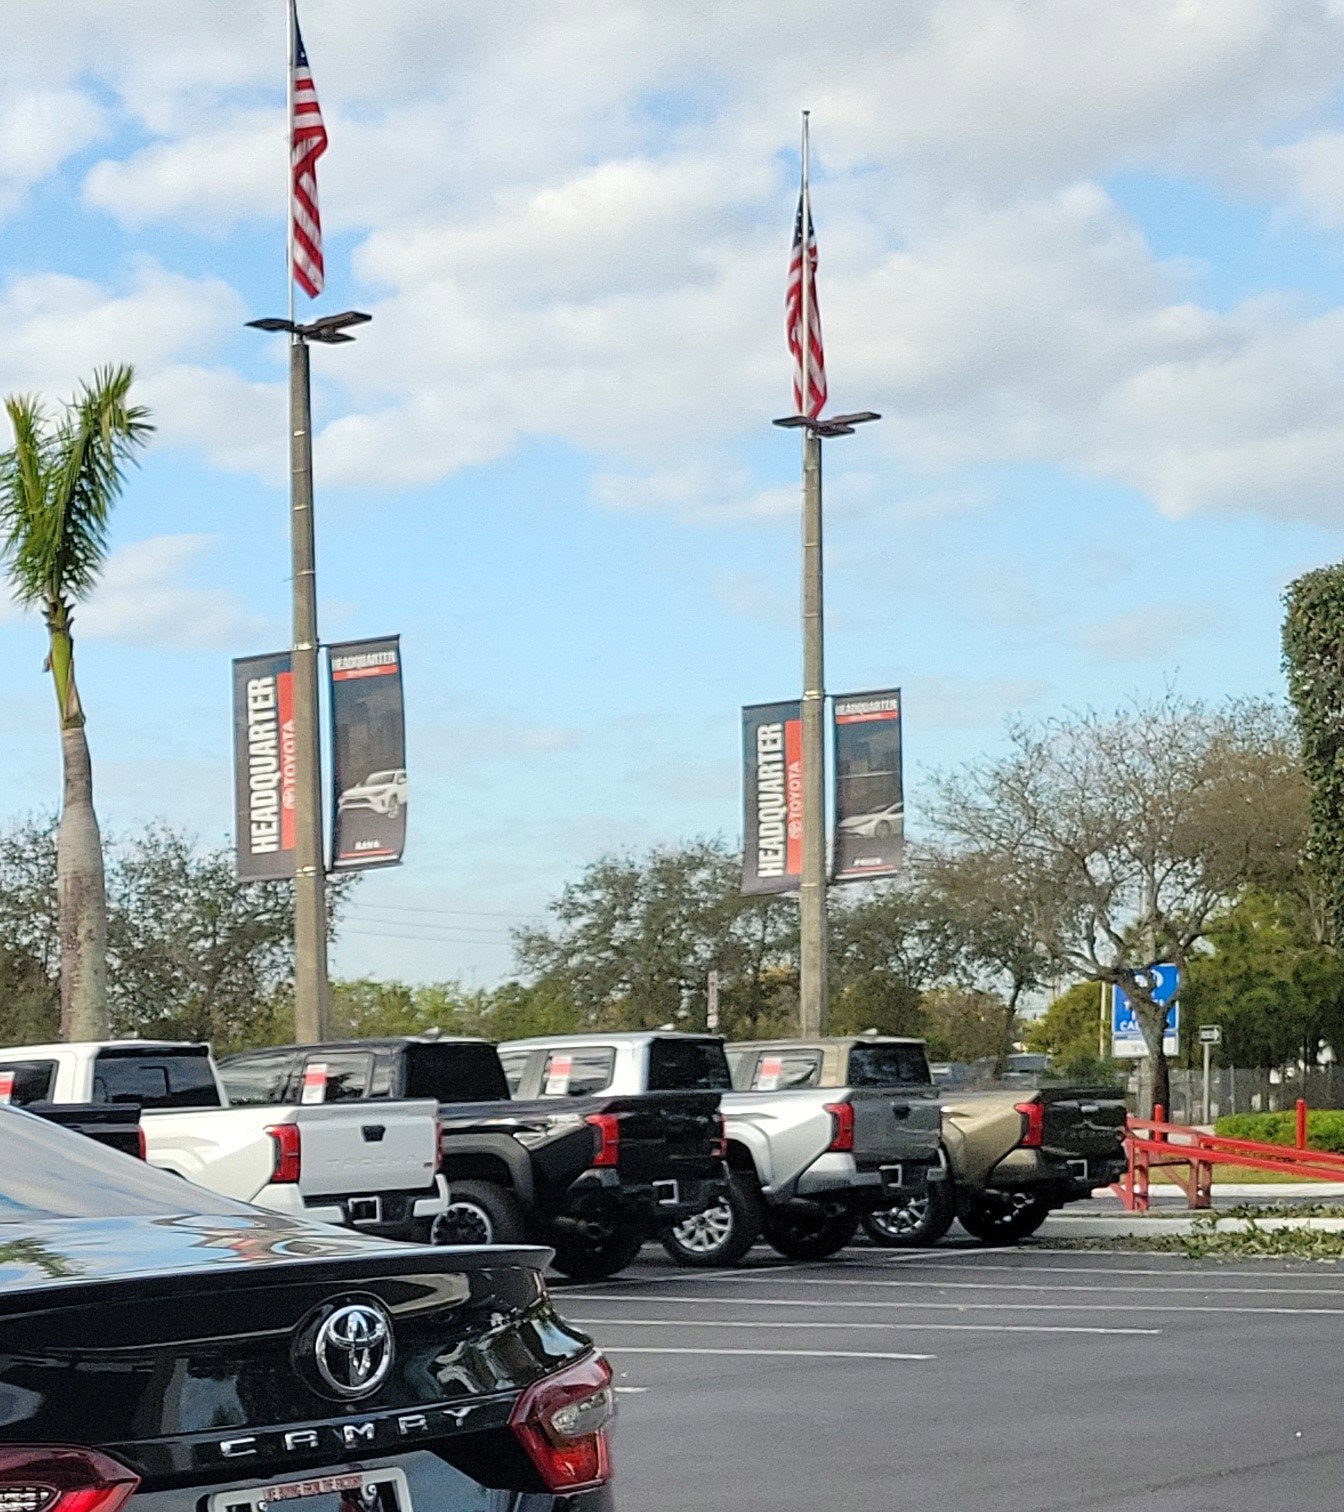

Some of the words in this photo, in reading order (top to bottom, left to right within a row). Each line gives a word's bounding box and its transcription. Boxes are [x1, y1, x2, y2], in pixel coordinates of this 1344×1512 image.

[247, 676, 282, 854] HEADQUARTER
[282, 719, 295, 788] TOYOTA
[757, 722, 787, 877] HEADQUARTER
[220, 1404, 480, 1458] CAMRY
